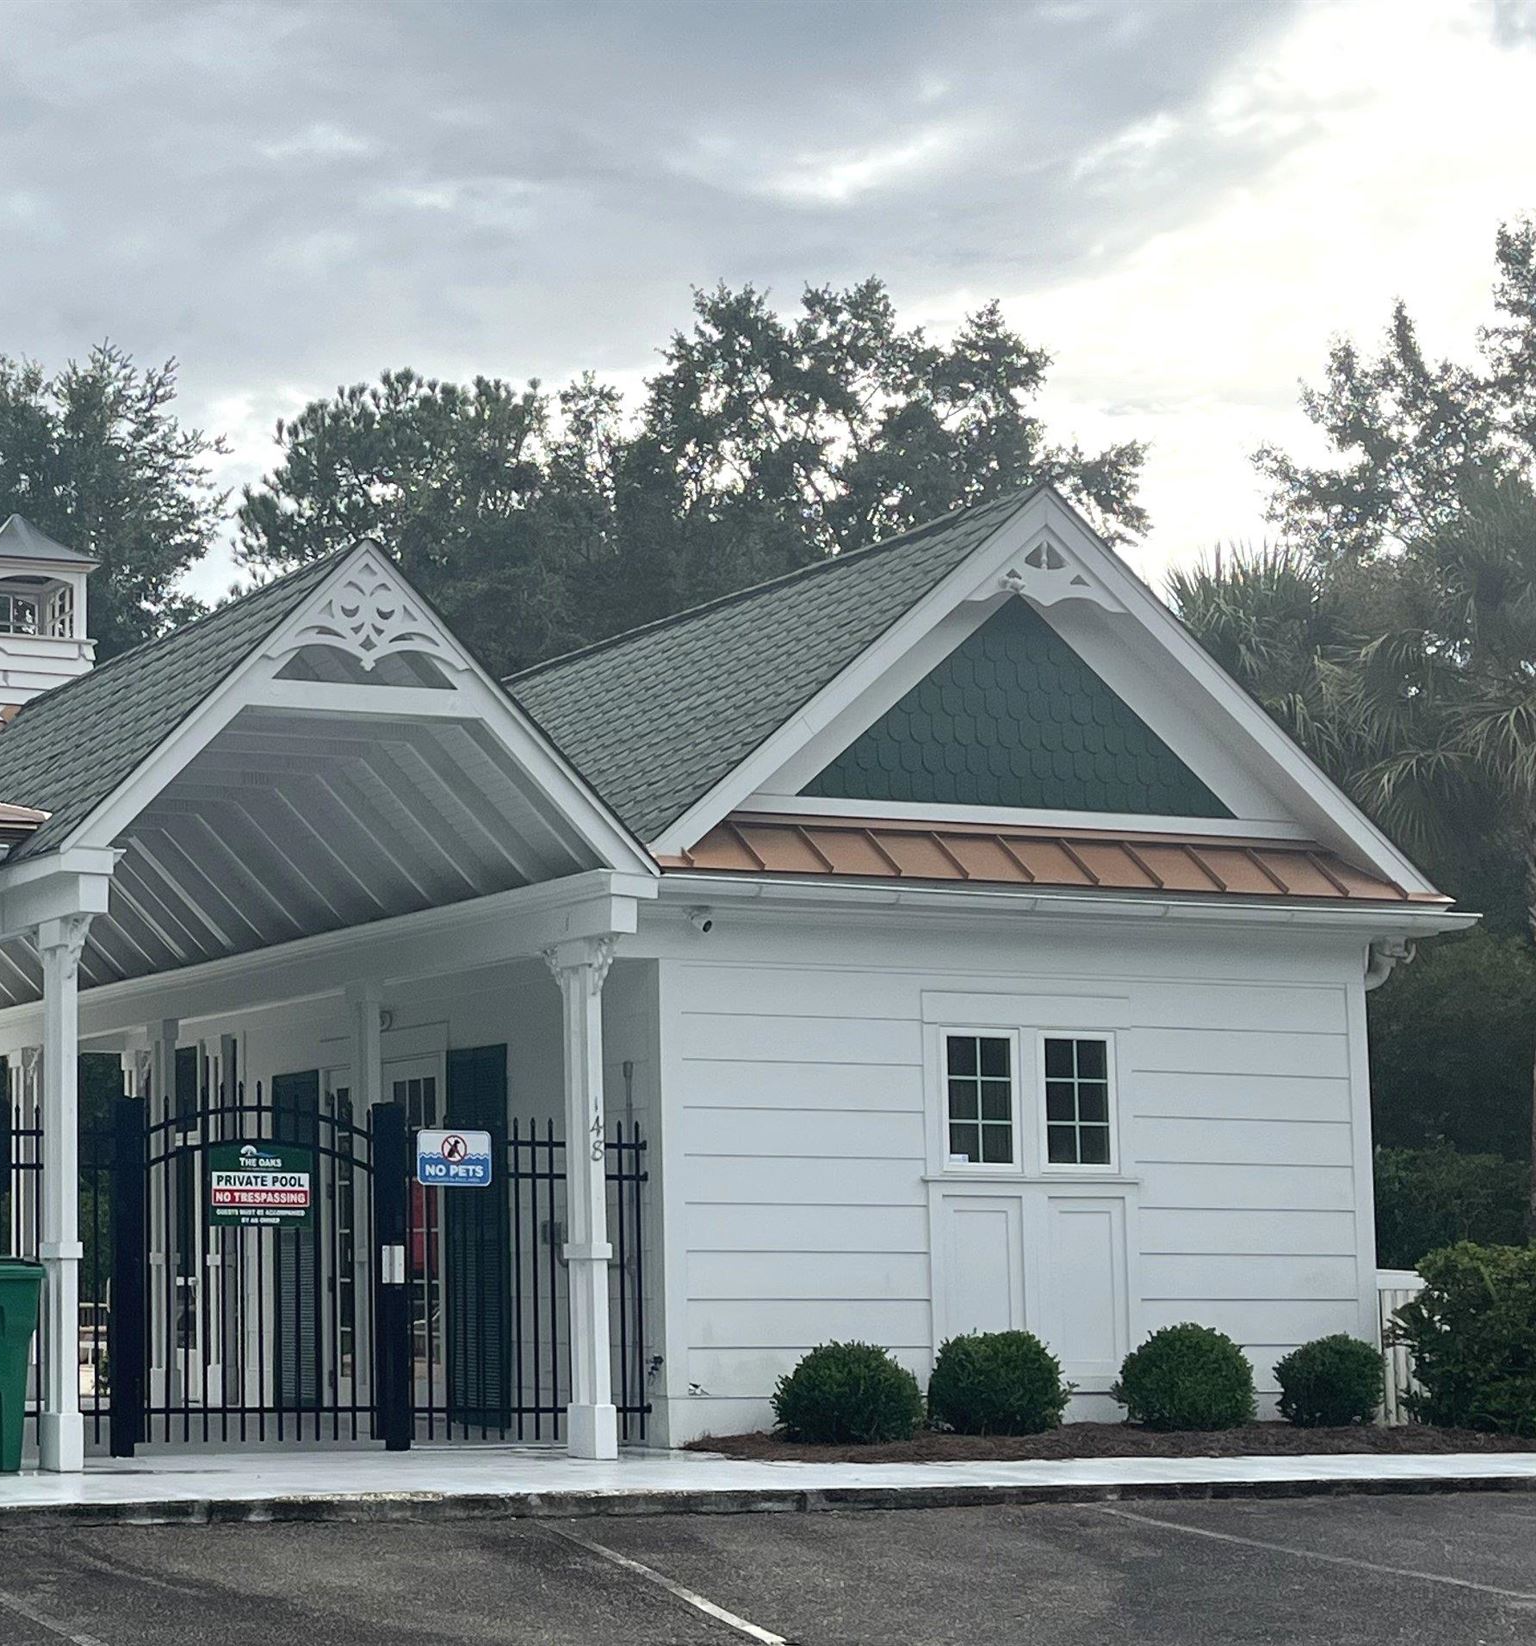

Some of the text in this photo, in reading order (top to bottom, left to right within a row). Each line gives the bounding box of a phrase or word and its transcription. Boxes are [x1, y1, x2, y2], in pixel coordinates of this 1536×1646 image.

[590, 1095, 604, 1161] 148
[239, 1157, 282, 1167] THE OAKS
[425, 1164, 484, 1177] NO PETS
[216, 1174, 305, 1187] PRIVATE POOL
[215, 1192, 306, 1203] NO TRESPASSING
